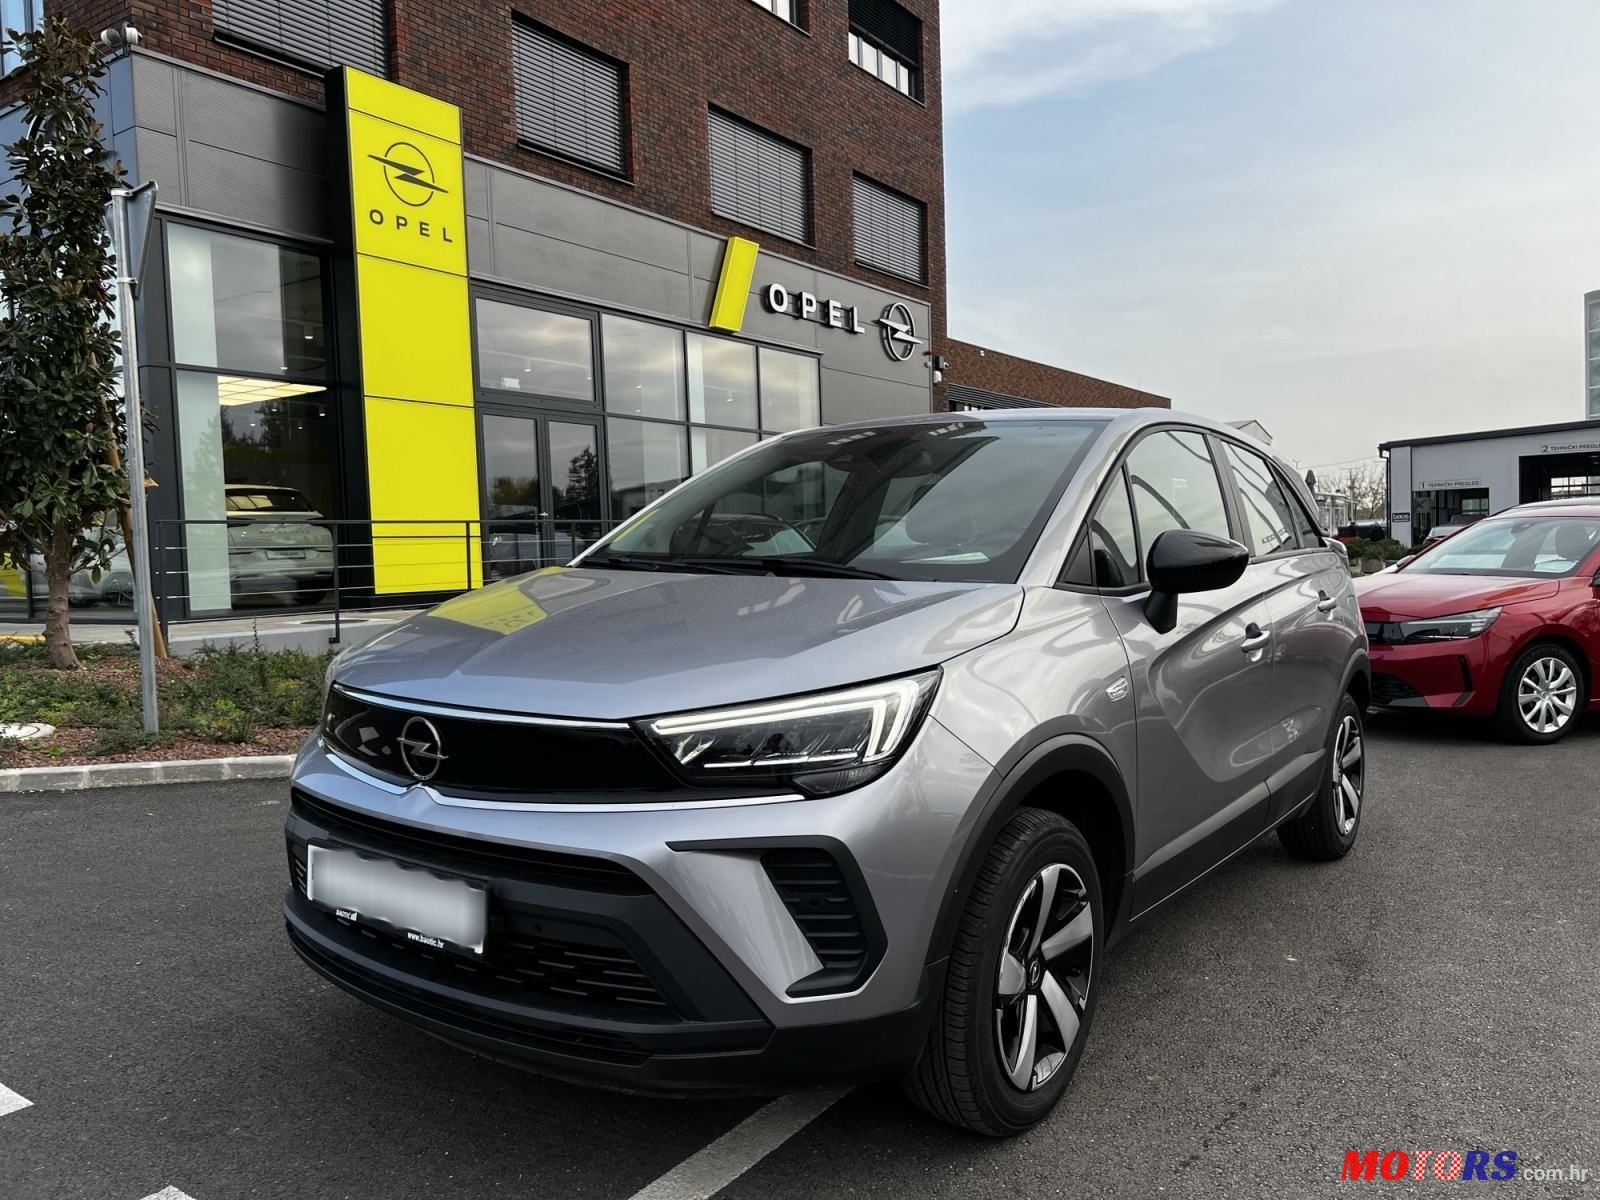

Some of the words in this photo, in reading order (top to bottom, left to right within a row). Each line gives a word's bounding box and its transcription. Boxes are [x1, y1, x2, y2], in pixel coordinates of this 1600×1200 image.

[369, 209, 453, 243] OPEL
[767, 283, 866, 334] OPEL
[407, 932, 444, 949] www.baotic.hr
